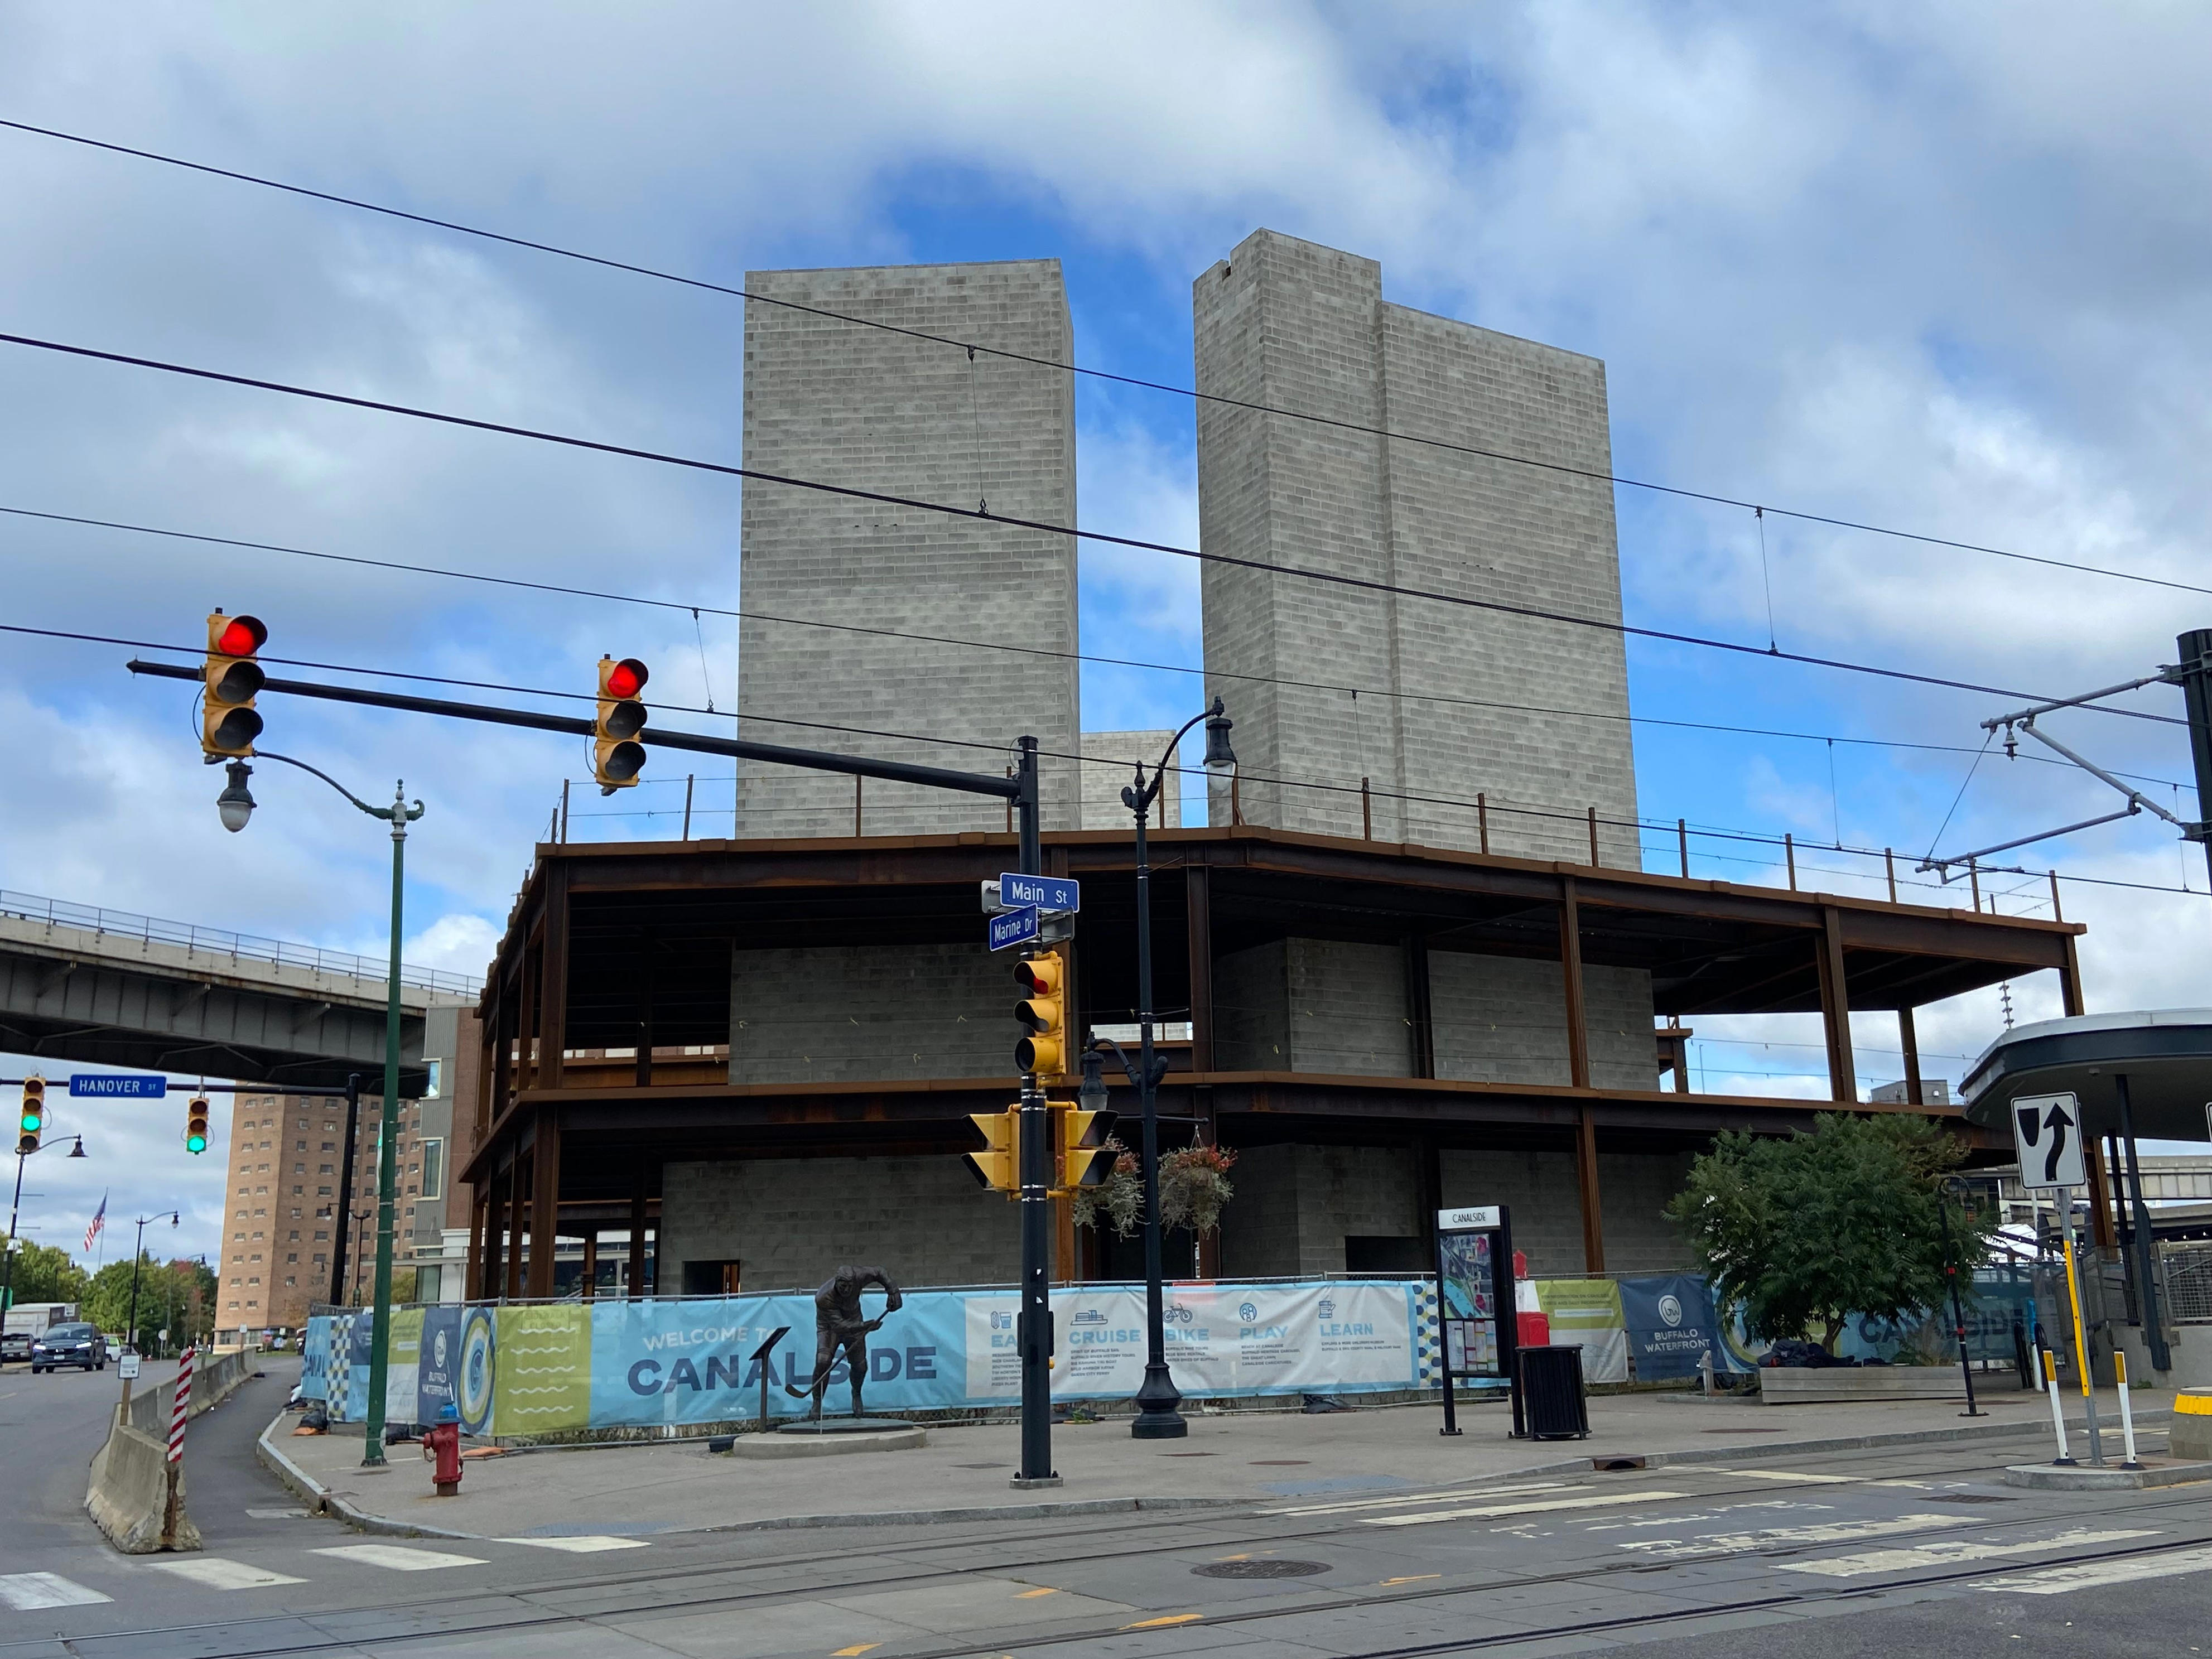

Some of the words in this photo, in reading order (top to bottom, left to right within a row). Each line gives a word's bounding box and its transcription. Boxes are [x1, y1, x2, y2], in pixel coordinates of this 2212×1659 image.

[1012, 881, 1044, 901] Main
[1056, 890, 1068, 904] St
[994, 920, 1021, 942] Marine
[1025, 918, 1032, 932] Dr
[79, 1079, 140, 1093] HANOVER
[1452, 1212, 1486, 1223] CANALSIDE
[1069, 1329, 1141, 1344] CRUISE
[1165, 1329, 1209, 1341] BIKE
[1240, 1326, 1288, 1339] PLAY
[1320, 1323, 1373, 1337] LEARN
[1654, 1329, 1698, 1341] BUFFALO
[643, 1327, 748, 1351] WELCOME
[992, 1334, 1017, 1348] EA
[1645, 1339, 1710, 1353] WATERFRONT
[628, 1346, 937, 1395] CANALSDE
